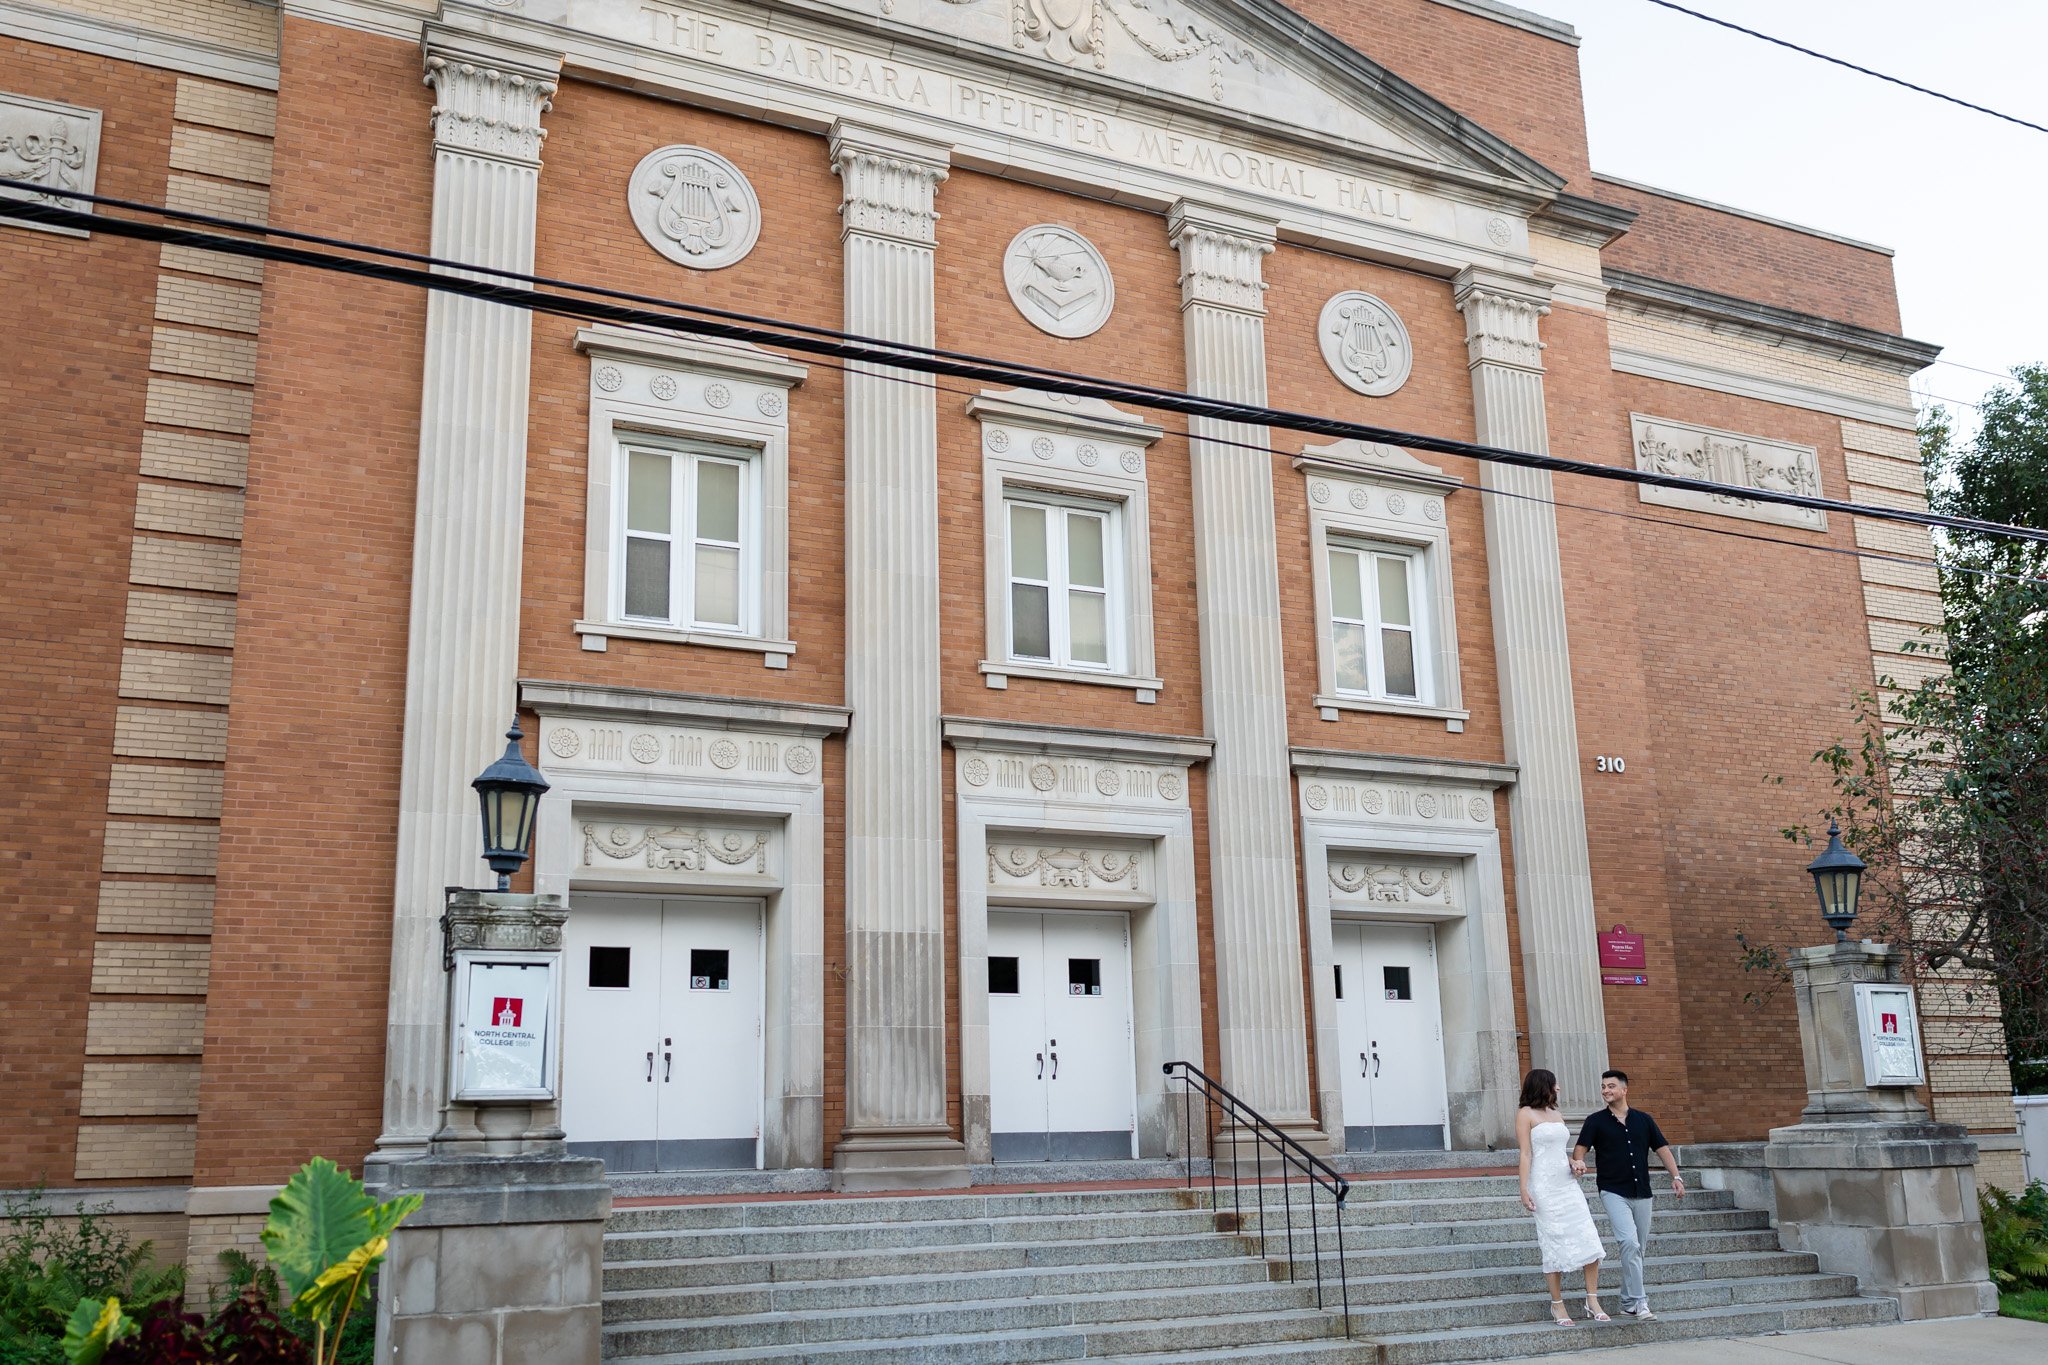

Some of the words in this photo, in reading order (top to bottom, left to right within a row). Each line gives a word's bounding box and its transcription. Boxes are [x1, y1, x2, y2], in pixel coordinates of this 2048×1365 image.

[640, 6, 723, 56] THE
[753, 34, 931, 107] BARBARA
[957, 84, 1114, 151] PFEIFFER
[1134, 130, 1317, 200] MEMORIAL
[1336, 178, 1412, 222] HALL
[1596, 756, 1625, 773] 310
[502, 1031, 535, 1039] CENTRAL
